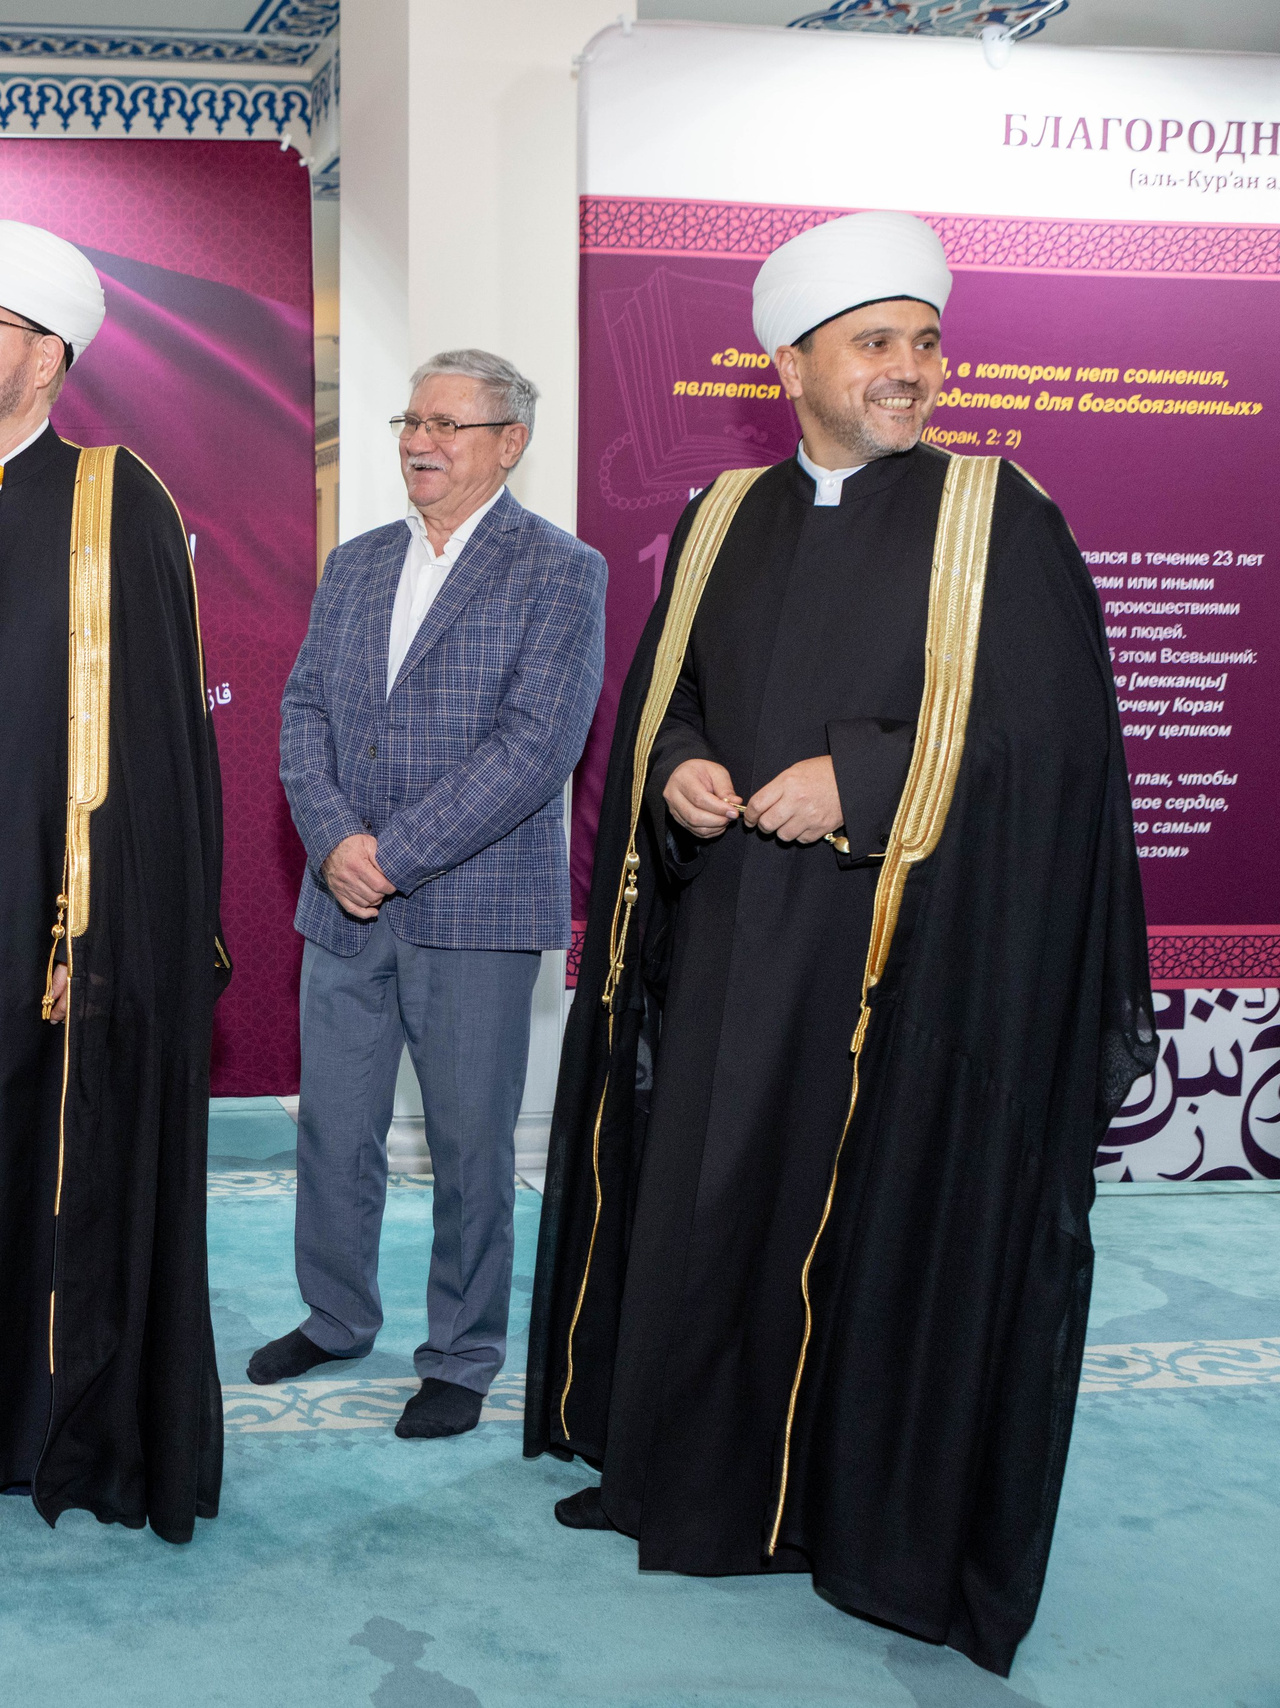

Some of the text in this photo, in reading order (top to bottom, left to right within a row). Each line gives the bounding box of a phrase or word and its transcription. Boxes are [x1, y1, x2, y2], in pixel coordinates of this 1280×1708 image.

[711, 348, 771, 369] «Это
[957, 362, 971, 378] в
[975, 363, 1072, 384] котором
[1075, 366, 1120, 383] нет
[1123, 368, 1229, 388] сомнения,
[673, 380, 781, 400] является
[1034, 391, 1074, 412] для
[1078, 392, 1263, 416] богобоязненных»
[921, 426, 1022, 450] (Коран, 2: 2)
[1131, 552, 1142, 565] в
[1145, 552, 1210, 566] течение
[1212, 550, 1234, 566] 23
[1236, 553, 1265, 567] лет
[1092, 576, 1215, 591] еми или иными
[1105, 601, 1240, 617] происшествиями
[1130, 623, 1187, 641] людей.
[1118, 650, 1157, 663] этом
[1160, 647, 1258, 664] Всевышний:
[1128, 672, 1228, 692] [мекканцы]
[1117, 696, 1225, 716] очему Коран
[1159, 724, 1232, 740] целиком
[1134, 773, 1173, 788] так,
[1177, 770, 1238, 786] чтобы
[1165, 793, 1229, 813] сердце,
[1152, 822, 1212, 834] самым
[1137, 846, 1190, 858] азом»
